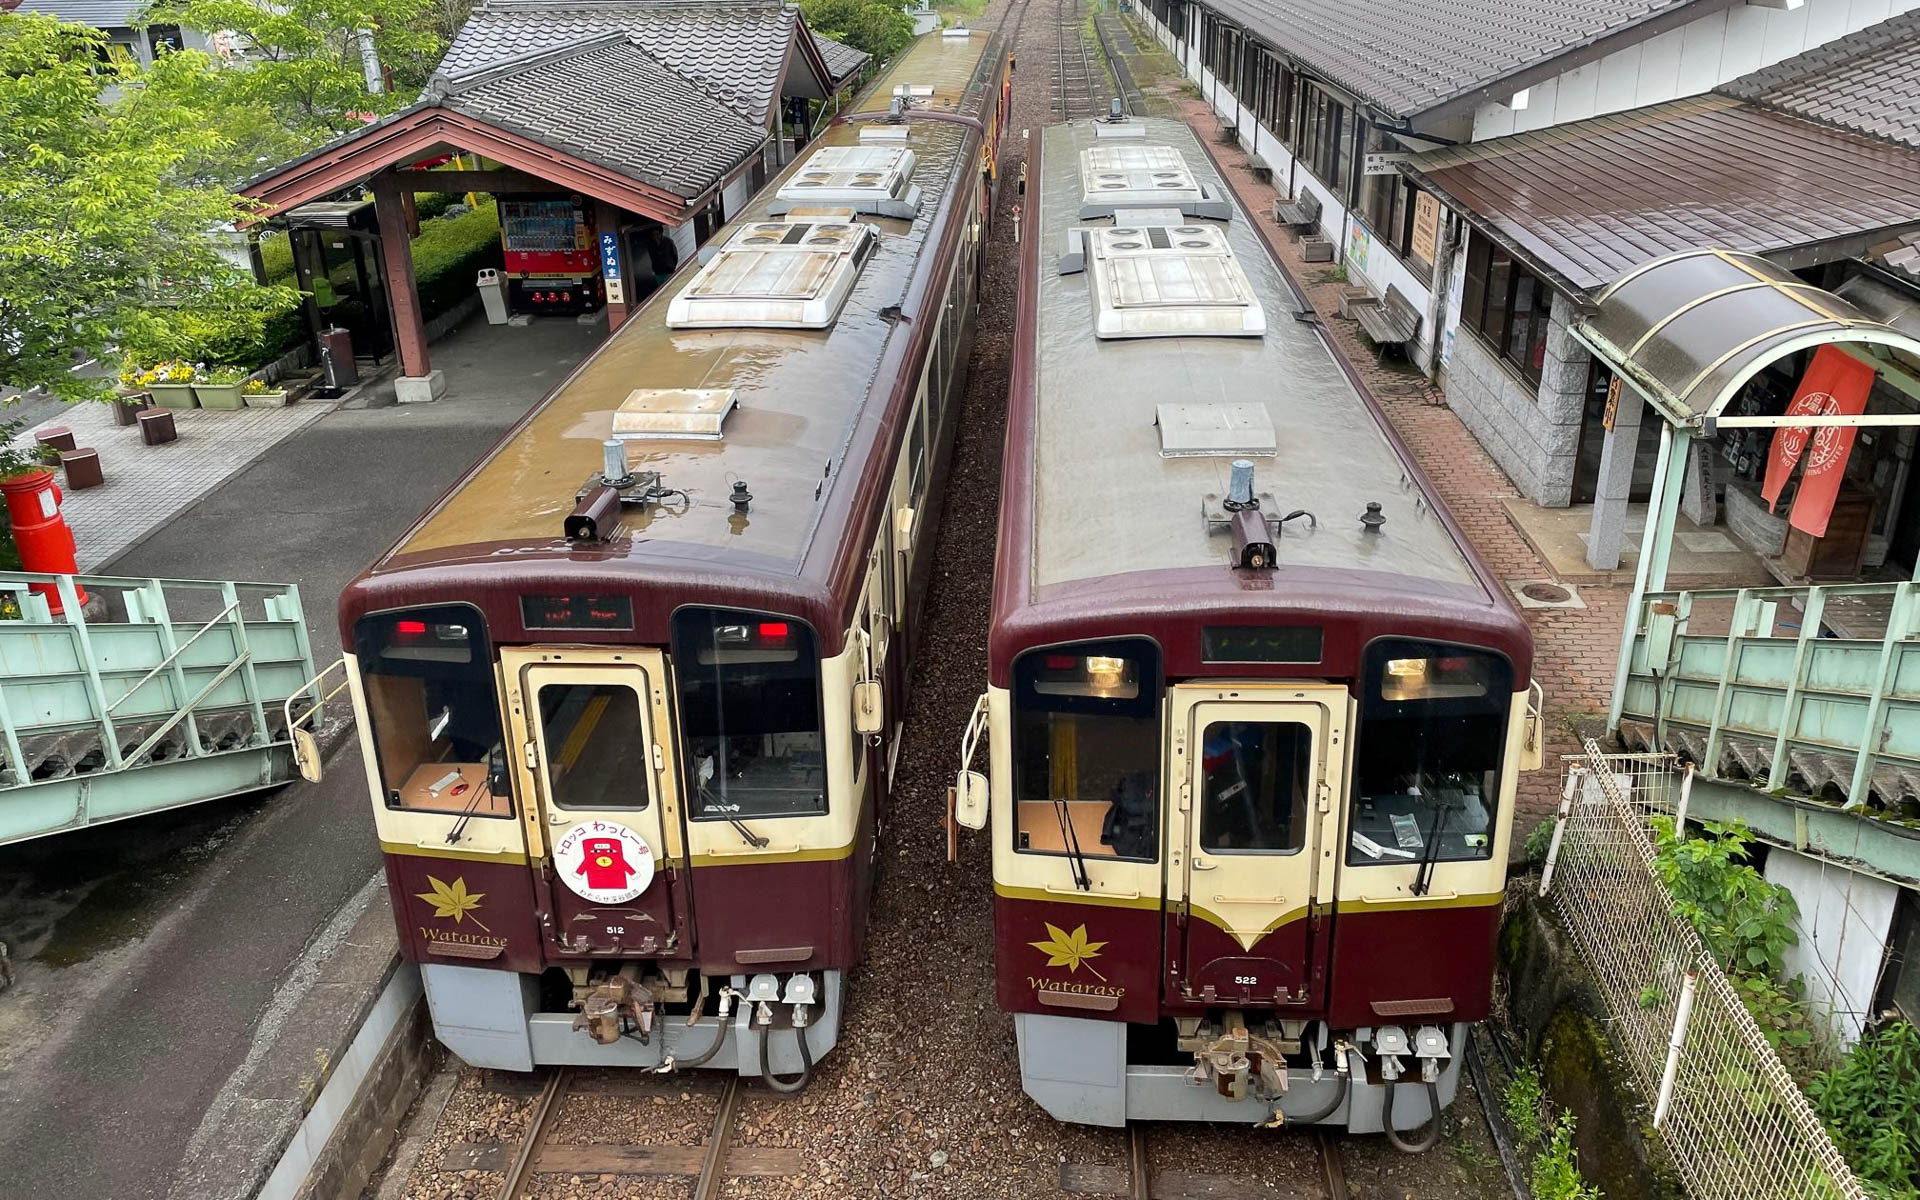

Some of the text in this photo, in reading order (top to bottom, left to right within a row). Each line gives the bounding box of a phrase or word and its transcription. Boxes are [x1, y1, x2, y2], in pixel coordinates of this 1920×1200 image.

[603, 235, 616, 277] みずぬま
[1823, 445, 1845, 472] CENTER
[558, 820, 650, 855] トロッコ わっしー号
[420, 926, 508, 947] Watarase
[606, 926, 625, 934] 512
[1026, 976, 1126, 997] Watarase
[1234, 976, 1257, 985] 522
